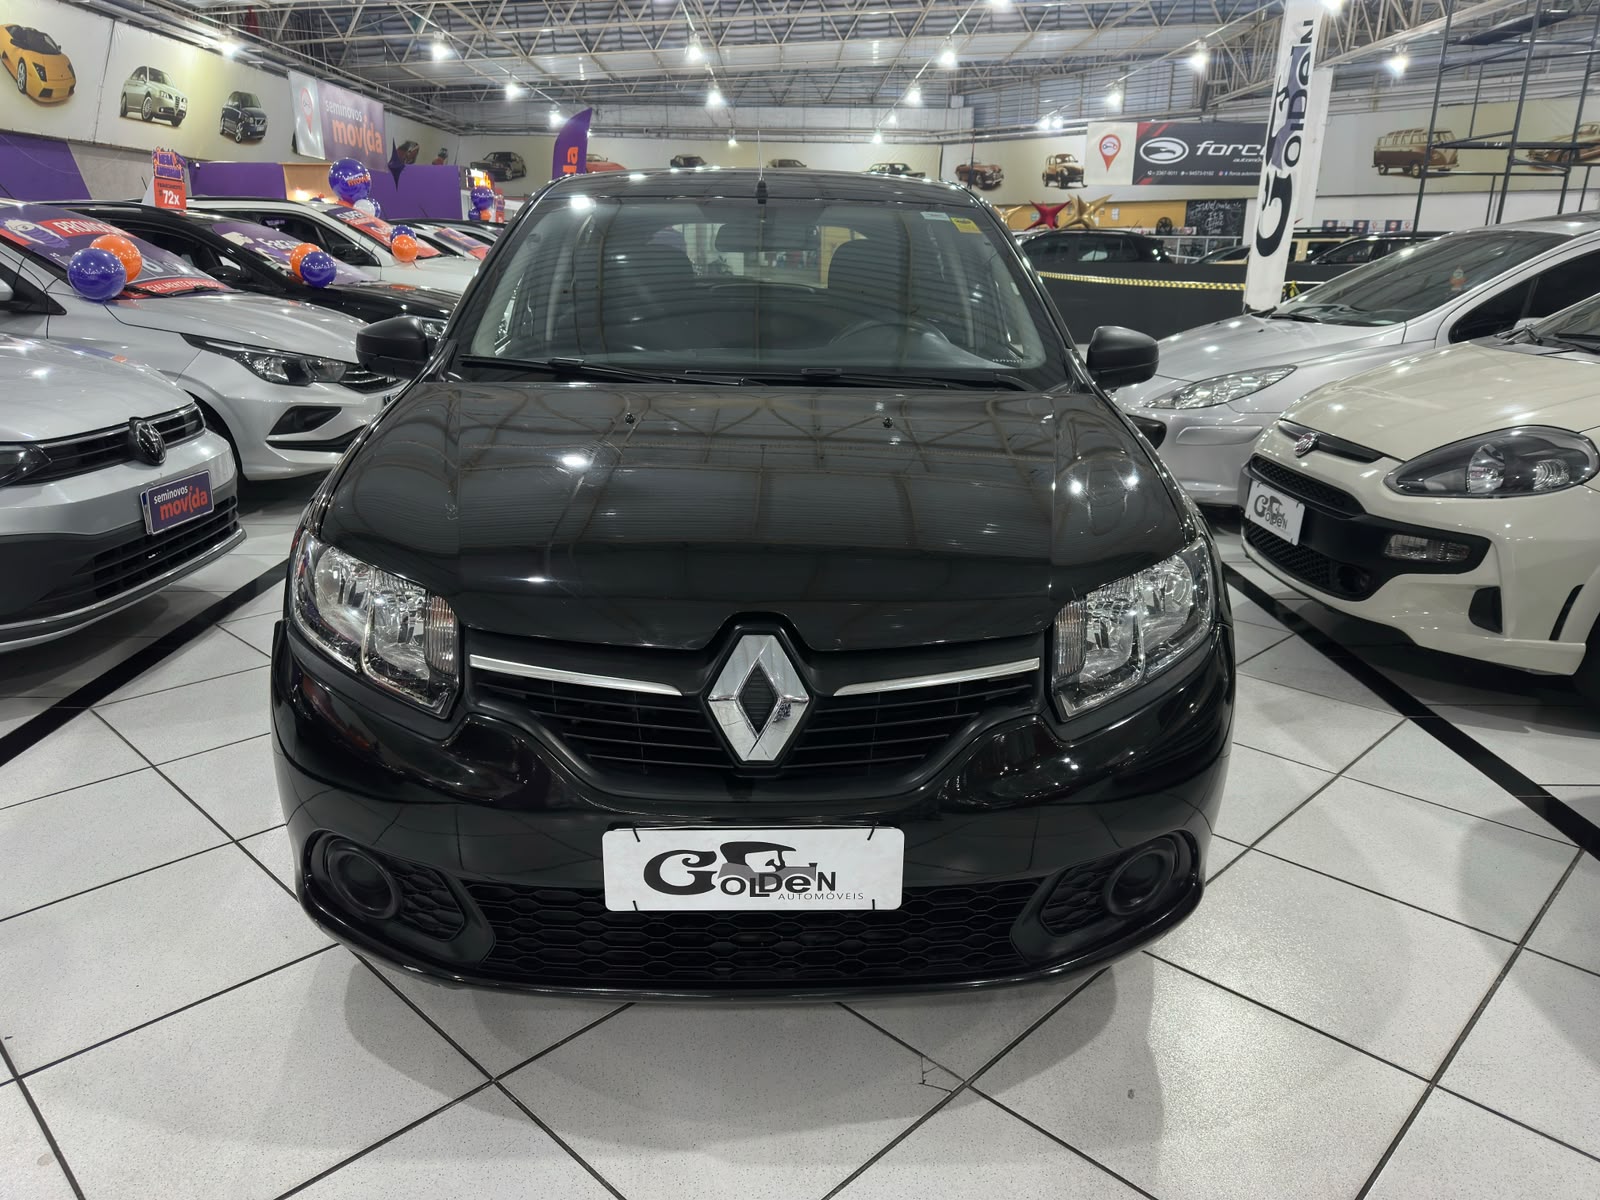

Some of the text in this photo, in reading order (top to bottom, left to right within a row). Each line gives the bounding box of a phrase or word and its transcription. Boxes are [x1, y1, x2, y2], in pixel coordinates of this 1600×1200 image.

[325, 99, 363, 122] seminovos
[332, 114, 384, 156] movida
[1196, 140, 1265, 155] forc
[162, 190, 180, 205] 72x
[153, 485, 188, 504] seminovos
[160, 485, 208, 520] movida
[777, 891, 864, 901] AUTOMÓVEIS
